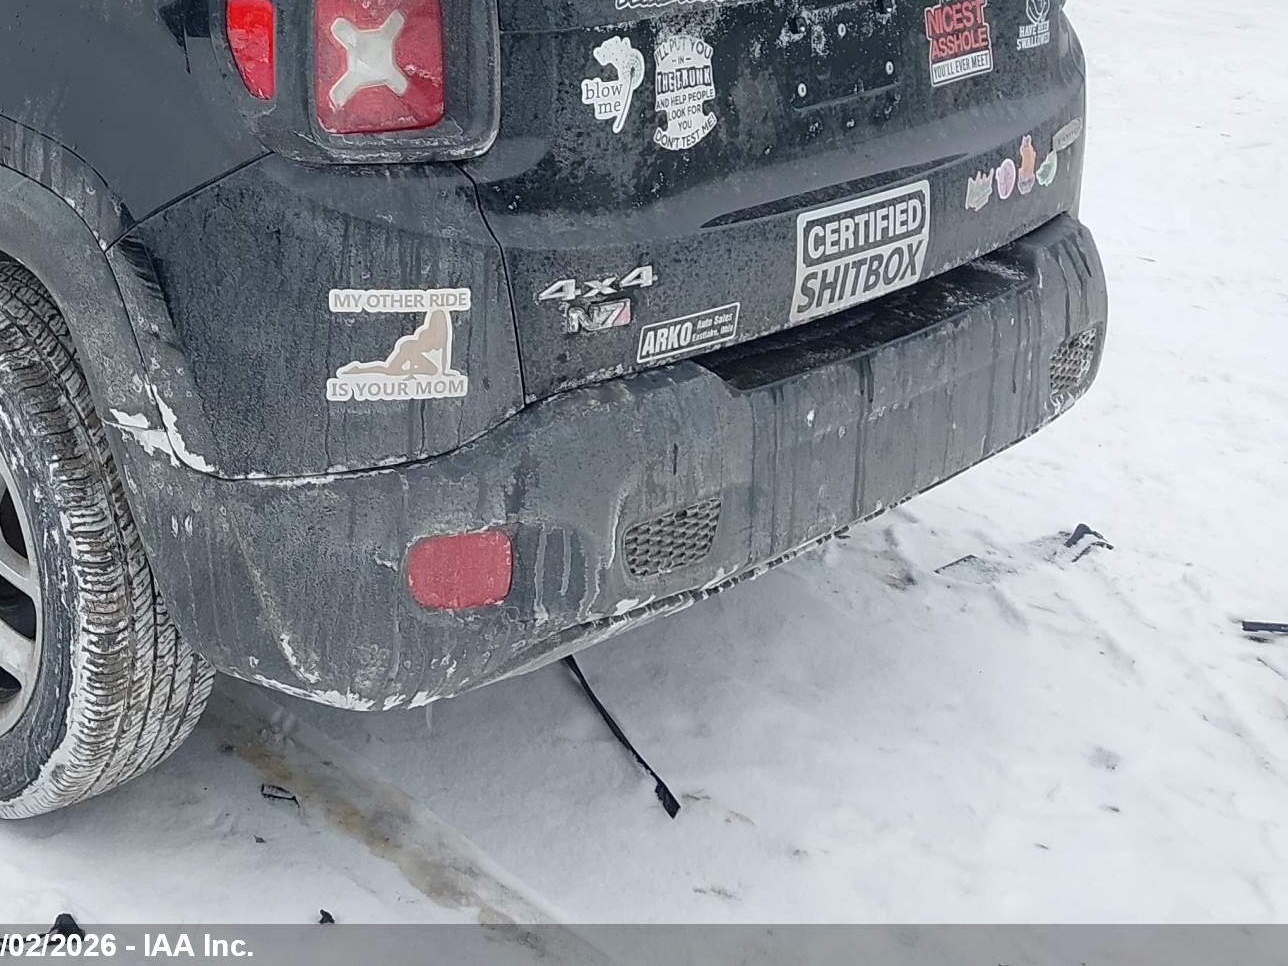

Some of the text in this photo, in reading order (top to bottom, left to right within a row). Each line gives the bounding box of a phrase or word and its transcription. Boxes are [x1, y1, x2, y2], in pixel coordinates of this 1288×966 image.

[1019, 25, 1037, 38] HAVE
[669, 36, 687, 52] PUT
[689, 38, 712, 59] YOU
[932, 27, 988, 59] ASSHOLE
[934, 54, 989, 80] YOU'LL EVER MEET
[657, 65, 712, 94] THE TRUNK
[585, 81, 623, 100] blow
[656, 89, 713, 109] AND HELP PEOPLE
[598, 101, 621, 114] me
[668, 104, 701, 121] LOOK FOR
[678, 119, 692, 131] YOU
[655, 129, 680, 148] DON'T
[681, 129, 700, 147] TEST
[807, 198, 922, 259] CERTIFIED
[796, 239, 924, 313] SHITBOX
[333, 292, 468, 308] MY OTHER RIDE
[641, 312, 734, 356] ARKO Auto Sales
[331, 379, 463, 396] IS YOUR MOM
